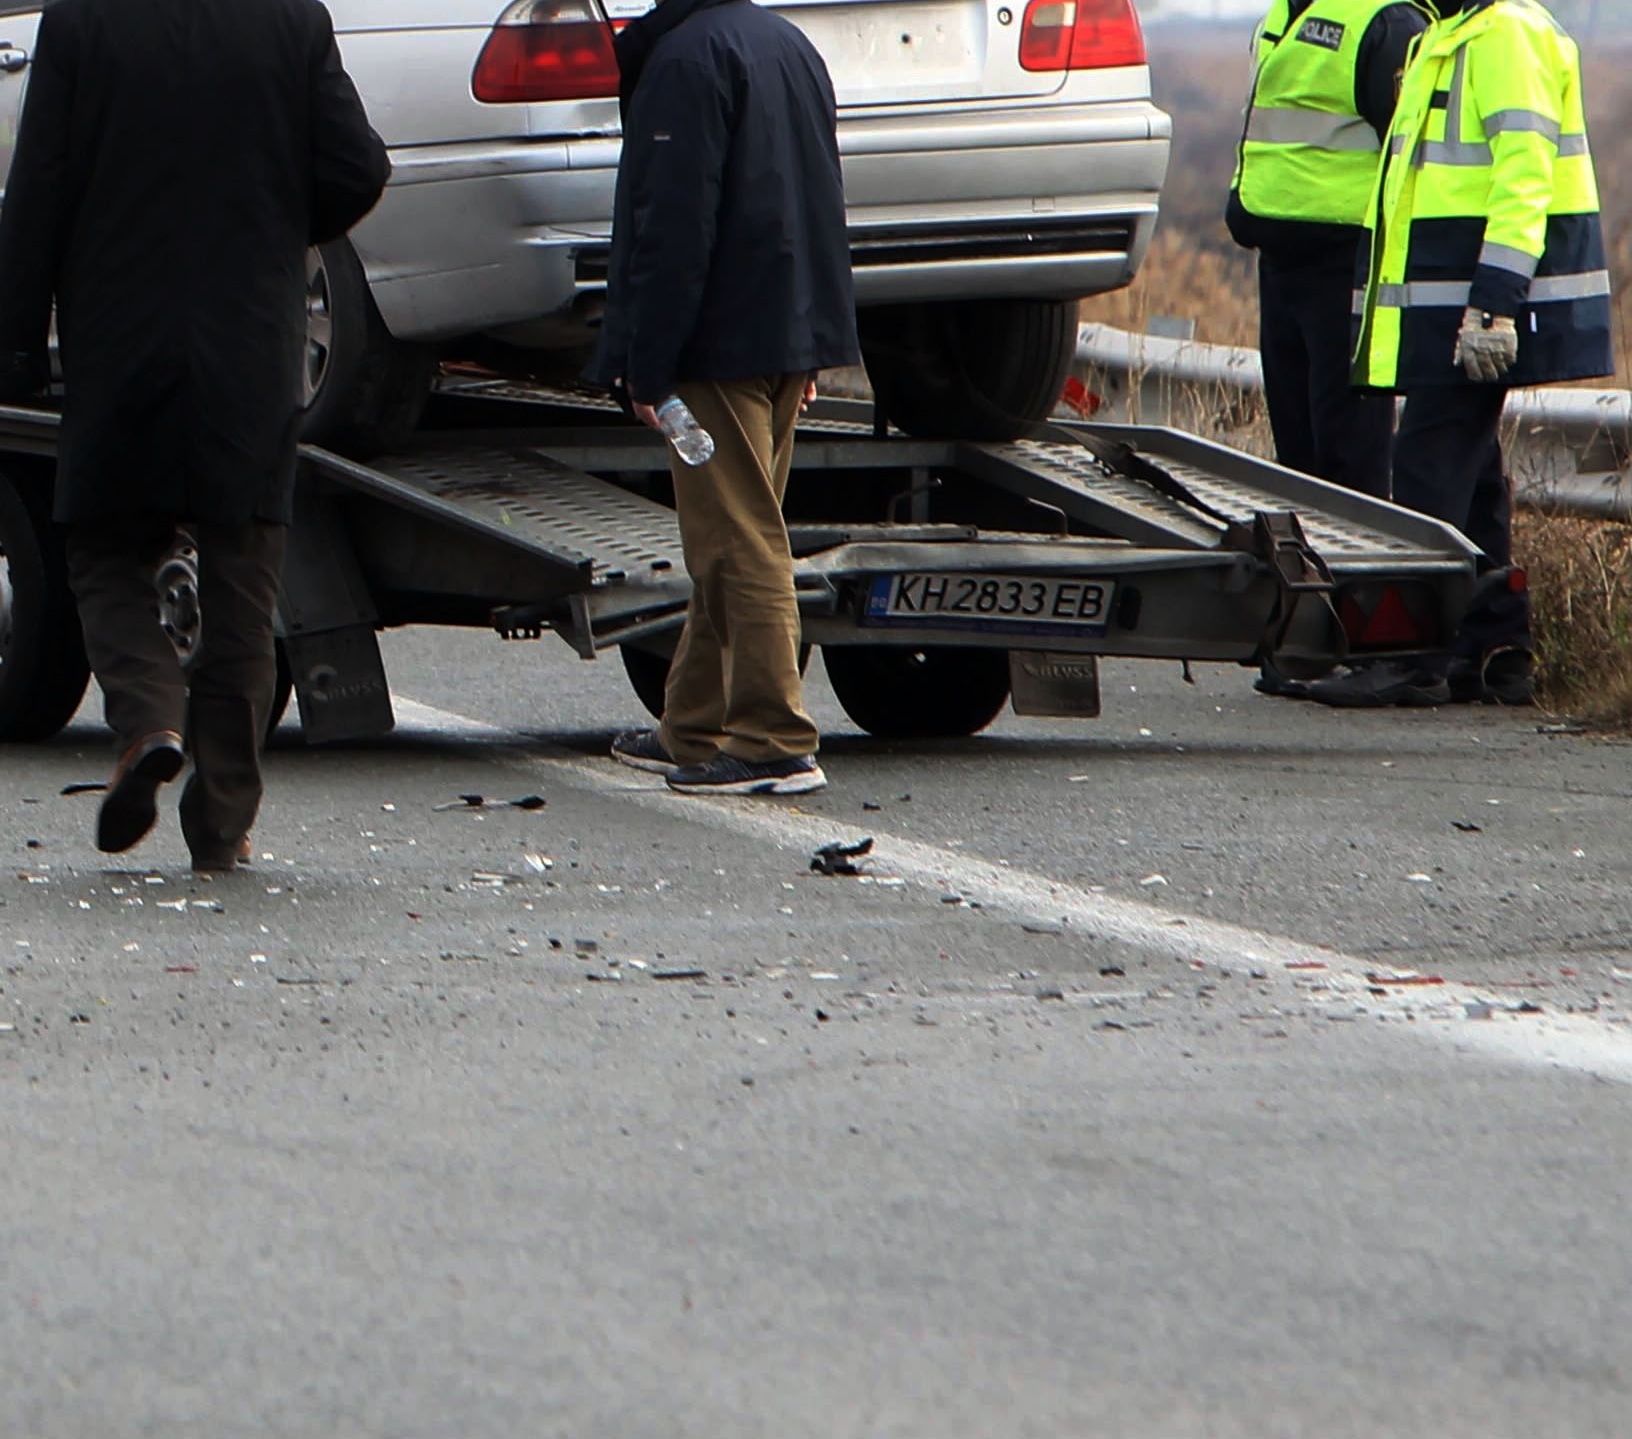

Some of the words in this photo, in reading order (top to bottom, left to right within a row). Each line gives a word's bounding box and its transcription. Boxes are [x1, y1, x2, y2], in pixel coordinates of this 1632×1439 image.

[894, 575, 949, 612] KH
[952, 579, 1047, 615] 2833
[1051, 582, 1105, 619] EB
